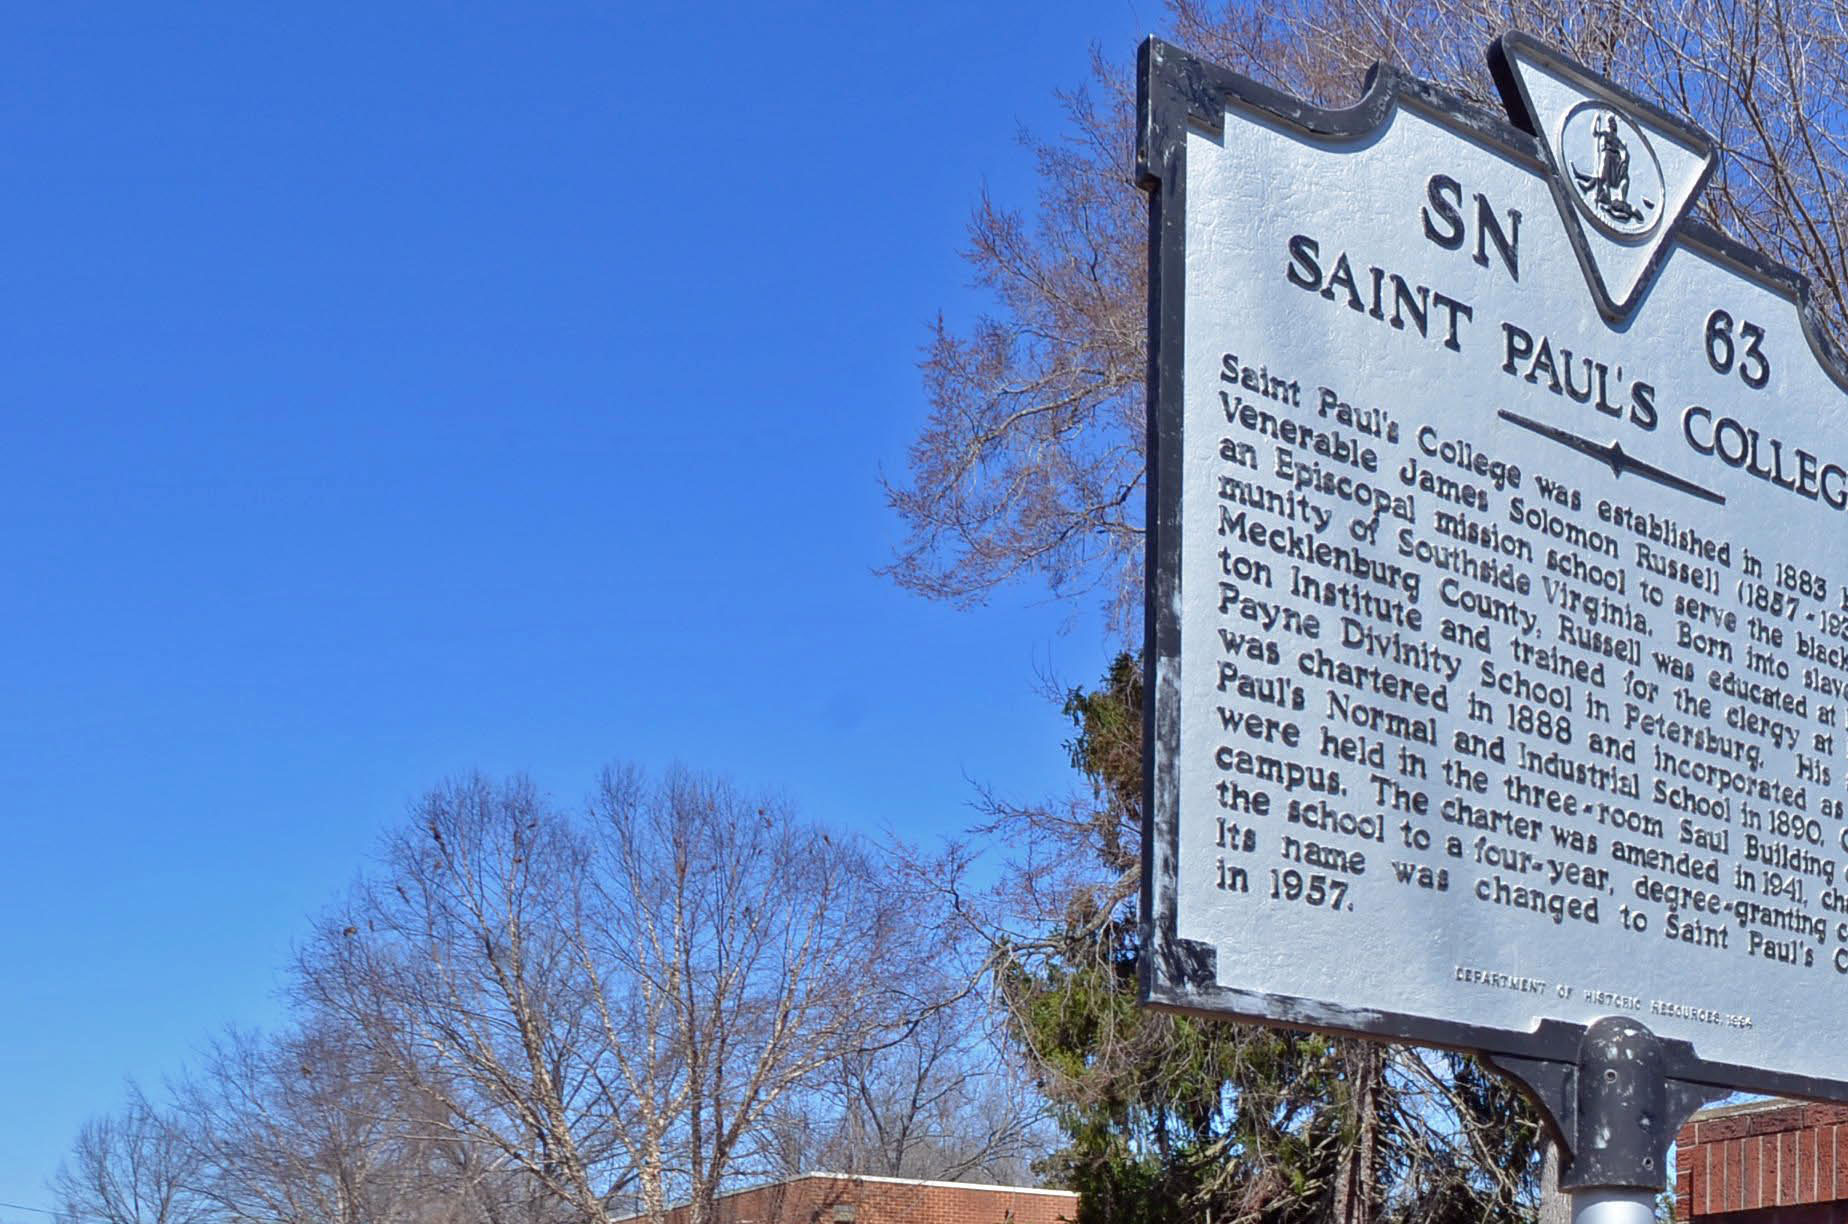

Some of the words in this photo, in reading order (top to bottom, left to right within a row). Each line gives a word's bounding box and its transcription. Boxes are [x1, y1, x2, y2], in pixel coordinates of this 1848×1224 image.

[1286, 234, 1473, 353] SAINT
[1501, 322, 1659, 432] PAUL'S
[1422, 174, 1523, 283] SN
[1705, 309, 1771, 390] 63
[1217, 389, 1378, 473] Venerable
[1399, 457, 1489, 513] James
[1508, 496, 1619, 560] Solomon
[1635, 542, 1720, 596] Russell
[1218, 437, 1258, 471] an
[1275, 446, 1416, 525] Episcopal
[1434, 510, 1534, 564] mission
[1546, 548, 1626, 596] school
[1639, 580, 1664, 607] to
[1674, 594, 1737, 633] serve
[1747, 616, 1783, 649] the
[1219, 353, 1301, 408] Saint
[1317, 387, 1399, 445] Paul's
[1417, 426, 1521, 492] College
[1534, 475, 1582, 512] was
[1597, 499, 1731, 569] established
[1742, 548, 1762, 580] in
[1775, 562, 1827, 603] 1883
[1217, 474, 1332, 534] munity
[1348, 517, 1380, 547] of
[1398, 527, 1531, 596] Southside
[1541, 575, 1653, 637] Virginia.
[1676, 619, 1733, 664] Born
[1746, 644, 1789, 681] into
[1217, 504, 1421, 605] Mecklenburg
[1439, 577, 1542, 639] County,
[1557, 613, 1641, 667] Russell
[1651, 651, 1695, 683] was
[1708, 670, 1808, 720] educated
[1817, 705, 1836, 728] at
[1217, 545, 1273, 589] ton
[1290, 565, 1422, 632] Institute
[1440, 618, 1492, 655] and
[1509, 636, 1606, 689] trained
[1623, 669, 1659, 704] for
[1672, 687, 1711, 720] the
[1726, 705, 1800, 751] clergy
[1813, 733, 1833, 757] at
[1216, 627, 1280, 666] was
[1297, 647, 1449, 714] chartered
[1467, 691, 1493, 725] in
[1507, 702, 1572, 746] 1888
[1588, 732, 1636, 765] and
[1654, 743, 1807, 812] incorporated
[1820, 798, 1844, 820] as
[1216, 659, 1306, 711] Paul's
[1326, 689, 1438, 747] Normal
[1454, 731, 1506, 765] and
[1517, 741, 1640, 800] Industrial
[1652, 778, 1731, 823] School
[1740, 800, 1762, 831] in
[1217, 581, 1320, 639] Payne
[1340, 617, 1462, 683] Divinity
[1480, 659, 1572, 713] School
[1586, 690, 1610, 724] in
[1623, 702, 1764, 773] Petersburg.
[1796, 752, 1831, 787] His
[1214, 745, 1347, 797] campus.
[1369, 774, 1429, 816] The
[1440, 796, 1543, 842] charter
[1549, 824, 1598, 855] was
[1611, 840, 1720, 885] amended
[1734, 863, 1756, 893] in
[1215, 705, 1301, 748] were
[1319, 725, 1385, 770] held
[1398, 745, 1427, 781] in
[1441, 758, 1488, 794] the
[1503, 774, 1664, 839] three-room
[1679, 818, 1729, 855] Saul
[1744, 833, 1836, 886] Building
[1215, 779, 1271, 817] the
[1287, 799, 1385, 843] school
[1399, 820, 1431, 851] to
[1446, 836, 1463, 859] a
[1634, 874, 1827, 945] degree-granting
[1215, 816, 1257, 853] Its
[1281, 835, 1366, 876] name
[1391, 861, 1449, 892] was
[1475, 875, 1599, 925] changed
[1619, 905, 1648, 933] to
[1664, 912, 1728, 950] Saint
[1748, 929, 1814, 968] Paul's
[1216, 856, 1249, 893] in
[1269, 868, 1354, 912] 1957.
[1454, 966, 1546, 996] DEPARTMENT
[1556, 983, 1573, 1001] OF
